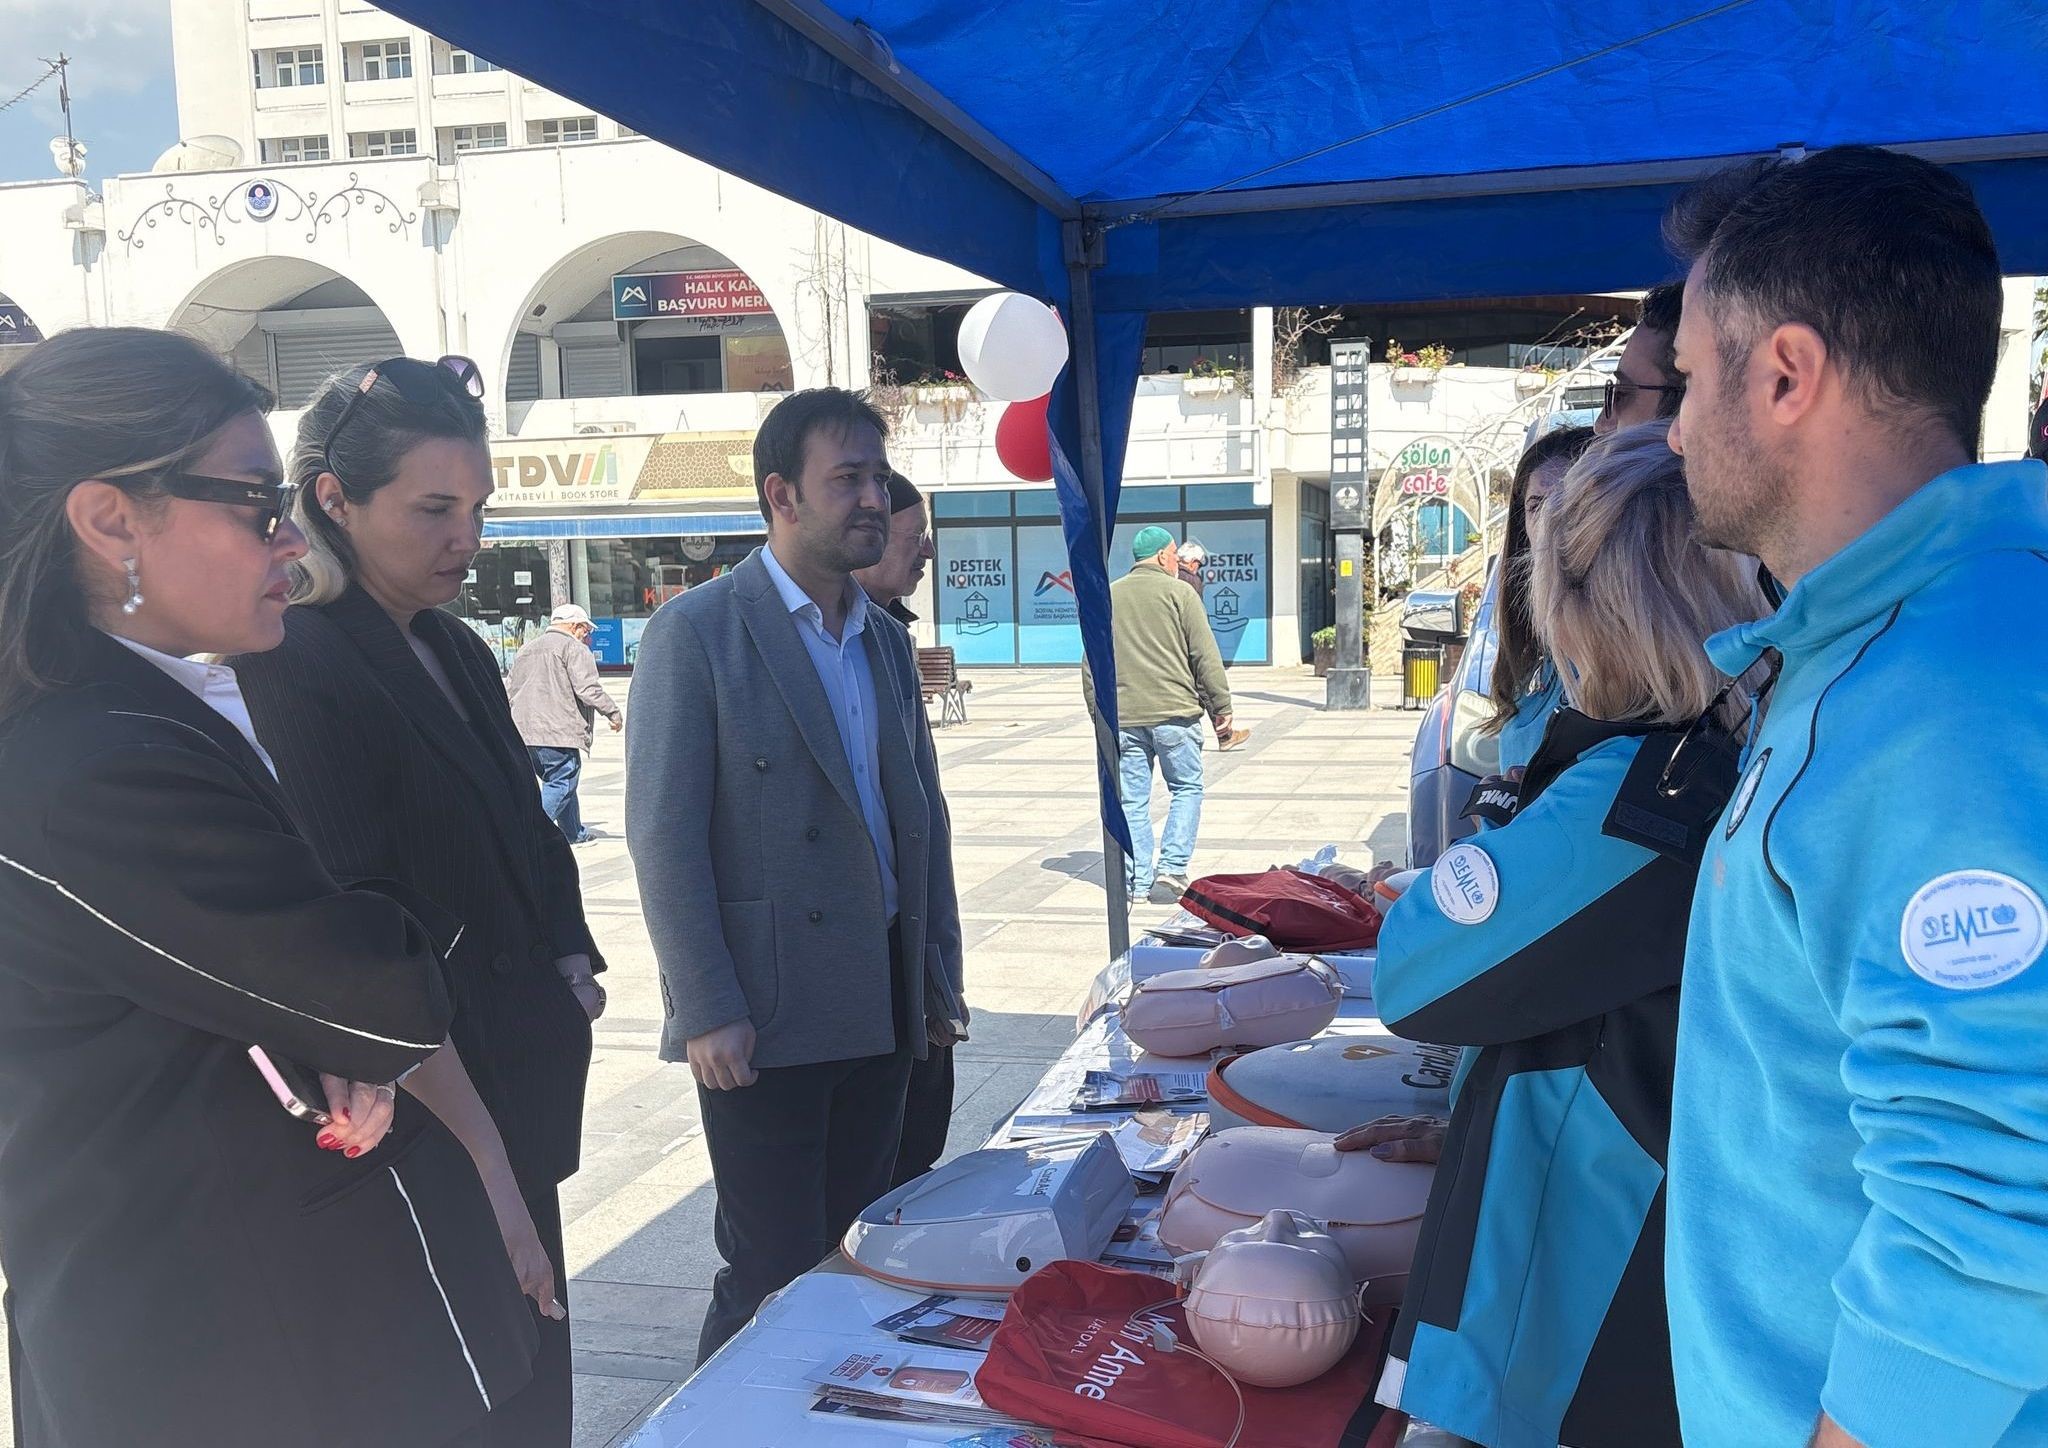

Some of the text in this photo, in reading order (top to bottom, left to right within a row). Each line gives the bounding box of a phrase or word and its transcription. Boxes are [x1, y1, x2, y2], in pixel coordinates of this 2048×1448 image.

[685, 281, 725, 294] HALK
[658, 296, 727, 314] BAŞVURU
[1401, 442, 1451, 473] şölen
[493, 453, 581, 489] TDV
[1403, 468, 1447, 493] cafe
[498, 488, 619, 502] KİTABEVİ BOOK STORE
[950, 558, 1002, 573] DESTEK
[946, 573, 1006, 589] NOKTASI
[1074, 1340, 1145, 1401] Anne
